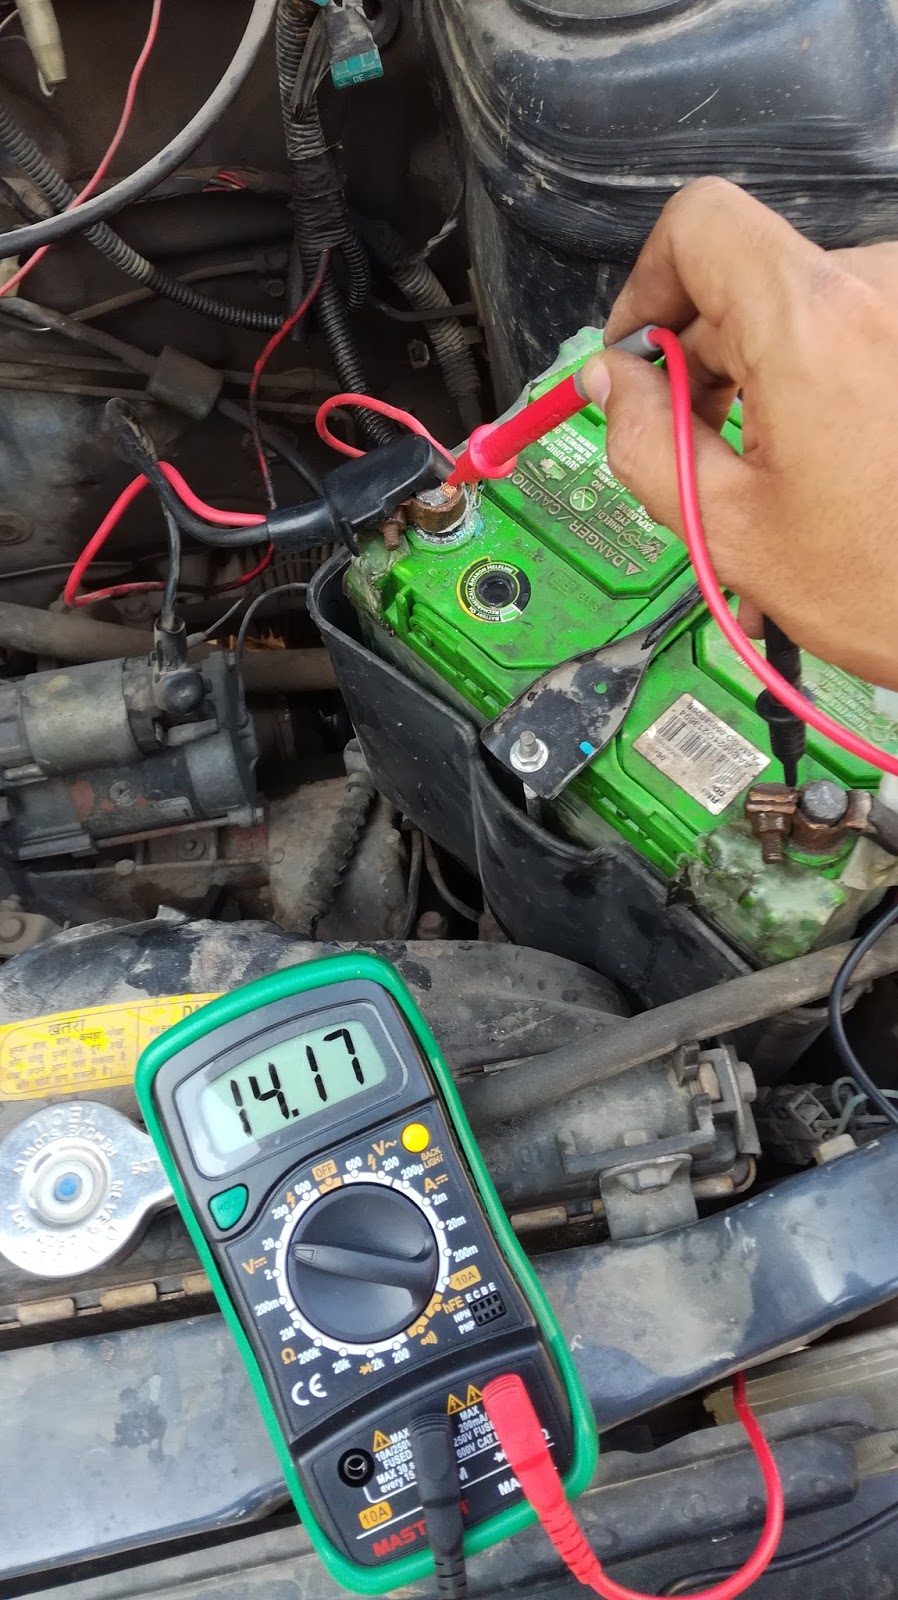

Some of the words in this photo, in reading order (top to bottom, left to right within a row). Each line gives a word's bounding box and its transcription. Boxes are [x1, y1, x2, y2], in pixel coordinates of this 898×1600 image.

[547, 443, 579, 471] SULFURIC
[573, 452, 586, 464] CAN
[591, 479, 604, 492] NO
[612, 510, 630, 526] EYES
[617, 502, 654, 532] EXPLOSIVE
[568, 519, 626, 567] DANGER
[48, 1019, 86, 1036] खतरा
[230, 1028, 364, 1137] 14.17
[420, 1146, 442, 1162] BACK
[422, 1153, 444, 1170] LIGHT
[316, 1162, 333, 1178] OFF
[345, 1156, 362, 1172] 600
[382, 1156, 400, 1172] 200
[294, 1180, 312, 1195] 600
[432, 1192, 448, 1206] 2m
[271, 1204, 289, 1220] 200
[446, 1215, 468, 1231] 20m
[262, 1237, 274, 1251] 20
[453, 1244, 479, 1263] 200m
[264, 1268, 273, 1281] 2
[456, 1271, 477, 1286] 10A
[464, 1294, 473, 1304] E
[472, 1290, 480, 1300] C
[480, 1286, 488, 1296] B
[488, 1282, 497, 1292] E
[254, 1300, 280, 1317] 200m
[442, 1296, 465, 1314] hFE
[453, 1308, 472, 1325] NPN
[278, 1326, 296, 1342] 2M
[458, 1320, 476, 1334] PNP
[297, 1347, 322, 1365] 200k
[392, 1347, 410, 1364] 200
[332, 1358, 352, 1374] 20k
[370, 1357, 386, 1372] 2k
[460, 1405, 480, 1422] MAX
[390, 1428, 410, 1444] MAX
[456, 1442, 476, 1458] 600V
[476, 1434, 494, 1448] CAT
[384, 1450, 412, 1470] FUSED
[376, 1470, 396, 1486] MAX
[398, 1464, 410, 1477] 30
[380, 1478, 404, 1494] every
[403, 1472, 416, 1482] 15
[362, 1508, 390, 1526] 10A
